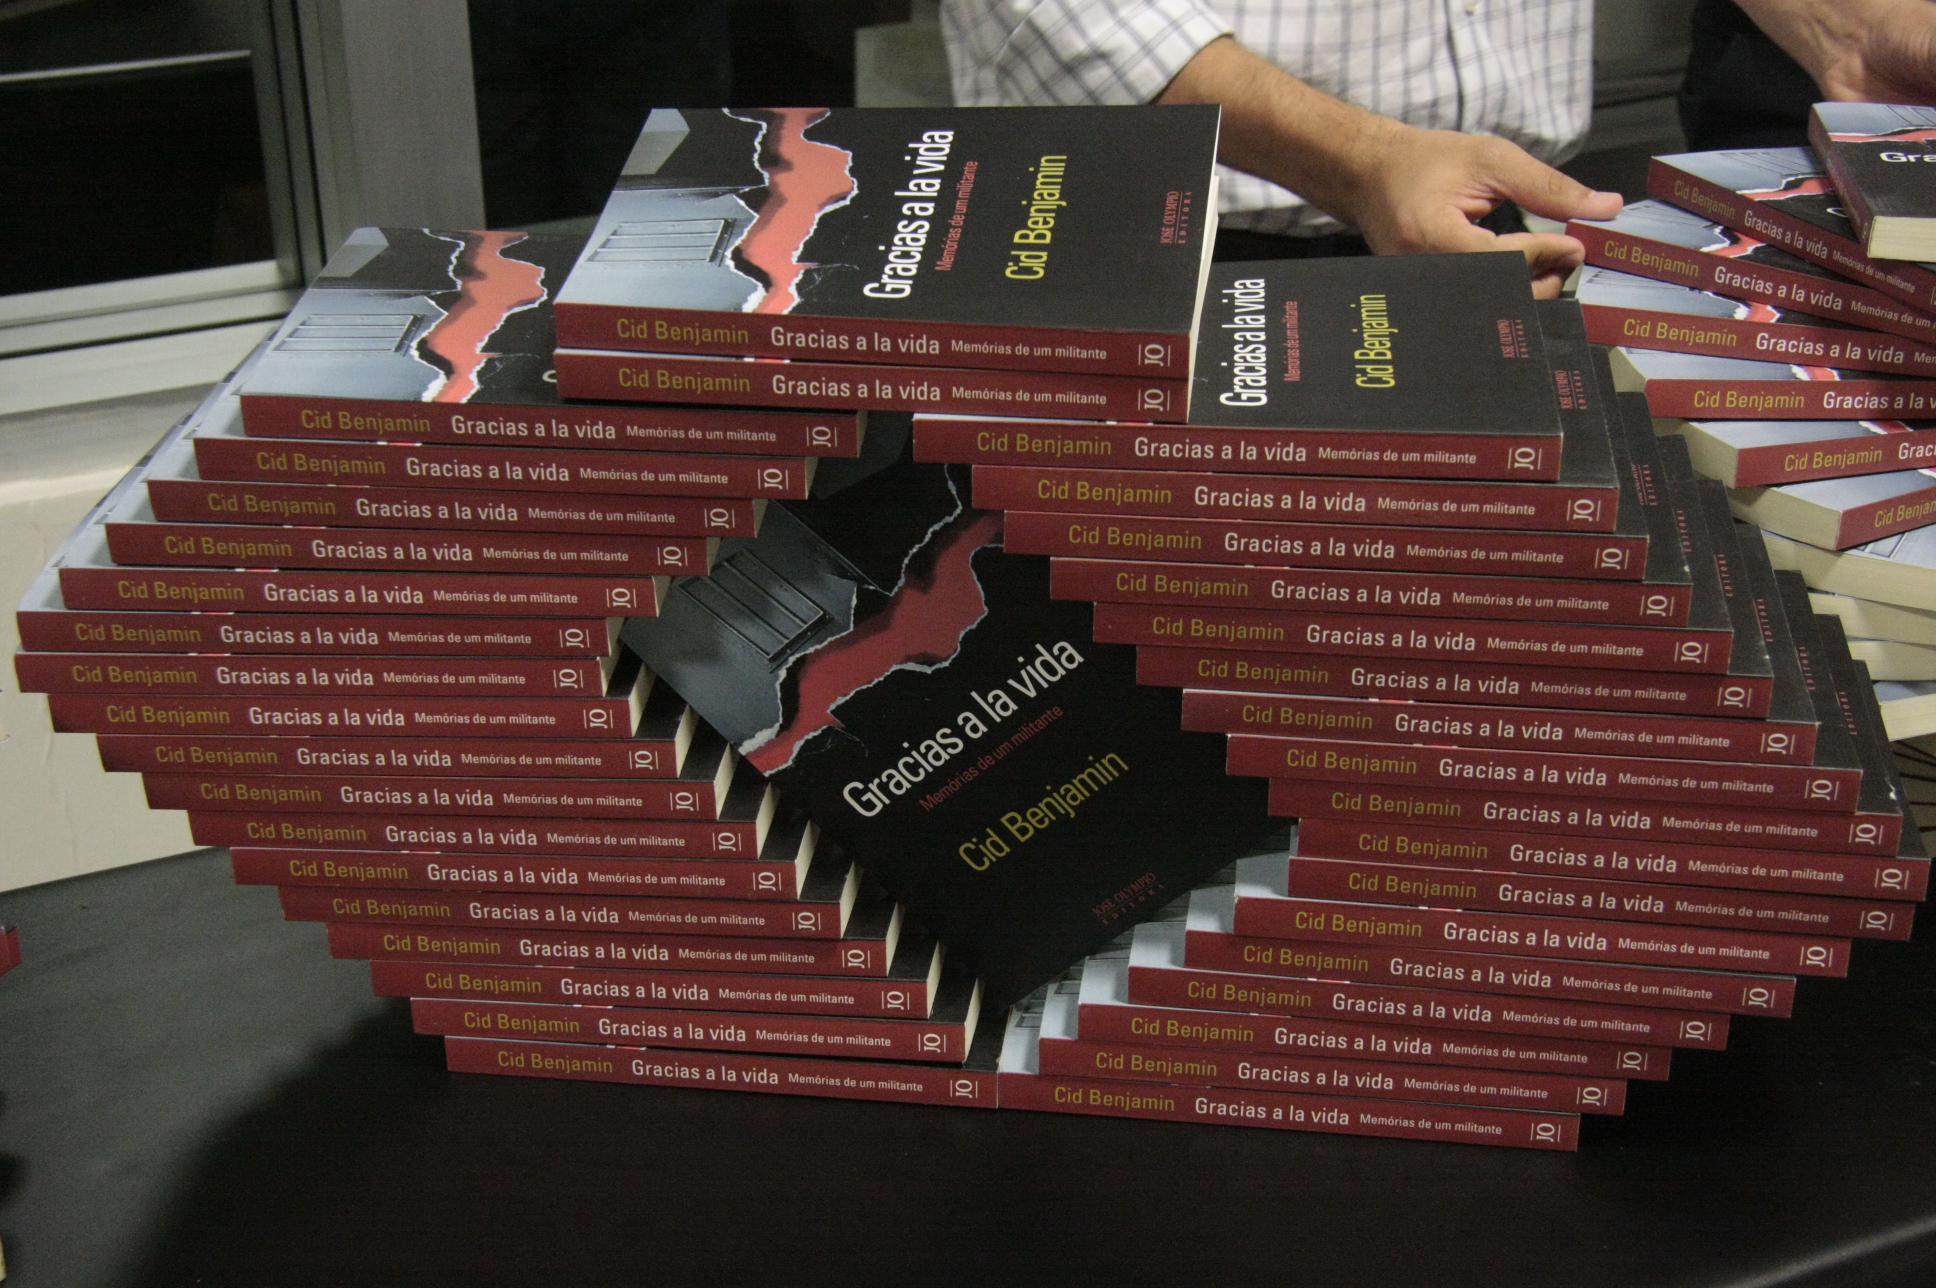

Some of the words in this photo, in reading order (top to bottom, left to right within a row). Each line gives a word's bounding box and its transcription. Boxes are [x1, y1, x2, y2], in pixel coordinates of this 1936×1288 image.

[904, 130, 954, 175] vida
[894, 178, 942, 196] la
[956, 160, 979, 198] militante
[902, 202, 936, 216] a
[954, 199, 968, 214] um
[1013, 155, 1068, 244] Benjamin
[1163, 190, 1179, 224] OLYMPIO
[948, 214, 965, 226] de
[1178, 191, 1192, 244] EDITORA
[1674, 179, 1690, 200] Cid
[1690, 186, 1736, 219] Benjamin
[1744, 209, 1783, 240] Gracias
[1784, 231, 1792, 244] a
[1793, 230, 1804, 249] la
[1806, 239, 1828, 259] vida
[1865, 264, 1874, 276] de
[1874, 270, 1886, 280] um
[862, 220, 931, 299] Gracias
[934, 227, 962, 272] Memórias
[1005, 250, 1048, 280] Cid
[1222, 278, 1266, 313] vida
[1604, 240, 1628, 260] Cid
[1630, 246, 1699, 277] Benjamin
[1714, 265, 1773, 295] Gracias
[1777, 284, 1787, 298] a
[1790, 283, 1805, 302] la
[1810, 289, 1842, 311] vida
[1850, 300, 1899, 321] Memórias
[1900, 312, 1914, 324] de
[1915, 317, 1931, 328] um
[1221, 314, 1266, 328] la
[1282, 300, 1299, 329] militante
[1350, 294, 1399, 360] Benjamin
[616, 317, 648, 339] Cid
[654, 320, 749, 346] Benjamin
[770, 325, 849, 350] Gracias
[855, 335, 867, 351] a
[874, 331, 891, 352] la
[897, 333, 940, 354] vida
[951, 339, 1012, 355] Memórias
[1014, 343, 1030, 356] de
[1033, 347, 1052, 356] um
[1054, 345, 1107, 360] militante
[1233, 331, 1266, 342] a
[1283, 339, 1300, 348] de
[1286, 329, 1299, 339] um
[1623, 318, 1651, 337] Cid
[1655, 321, 1737, 346] Benjamin
[1755, 332, 1824, 356] Gracias
[1829, 344, 1840, 357] a
[1845, 341, 1861, 360] la
[1867, 344, 1904, 364] vida
[1219, 343, 1268, 407] Gracias
[1284, 348, 1300, 382] Memórias
[1355, 364, 1396, 388] Cid
[1693, 390, 1720, 408] Cid
[1725, 390, 1805, 412] Benjamin
[1823, 391, 1889, 409] Gracias
[1893, 396, 1903, 409] a
[1908, 392, 1924, 409] la
[301, 409, 332, 429] Cid
[337, 410, 431, 435] Benjamin
[451, 414, 528, 436] Gracias
[534, 422, 546, 437] a
[551, 418, 569, 438] la
[574, 419, 616, 439] vida
[626, 425, 685, 439] Memórias
[687, 427, 702, 439] de
[705, 430, 723, 439] um
[726, 429, 776, 442] militante
[1784, 453, 1808, 472] Cid
[1812, 446, 1883, 469] Benjamin
[1874, 507, 1894, 528] Cid
[71, 664, 102, 683] Cid
[107, 665, 197, 687] Benjamin
[216, 666, 291, 685] Gracias
[295, 671, 307, 685] a
[311, 667, 329, 685] la
[334, 668, 374, 686] vida
[383, 671, 439, 684] Memórias
[441, 672, 456, 684] de
[458, 675, 476, 684] um
[478, 673, 526, 685] militante
[1007, 640, 1085, 699] vida
[970, 690, 1019, 722] la
[956, 710, 988, 740] a
[1242, 704, 1273, 723] Cid
[1280, 706, 1373, 730] Benjamin
[1395, 713, 1473, 735] Gracias
[1479, 722, 1490, 736] a
[1497, 719, 1515, 738] la
[1521, 721, 1563, 741] vida
[1574, 727, 1635, 742] Memórias
[1637, 731, 1653, 743] de
[1656, 735, 1675, 744] um
[1677, 734, 1730, 747] militante
[842, 724, 965, 818] Gracias
[918, 764, 979, 812] Memórias
[976, 750, 996, 771] de
[993, 740, 1014, 760] um
[1010, 704, 1064, 748] militante
[958, 827, 1011, 872] Cid
[1000, 752, 1129, 843] Benjamin
[497, 1050, 525, 1068] Cid
[530, 1052, 613, 1074] Benjamin
[631, 1059, 700, 1079] Gracias
[705, 1068, 715, 1080] a
[721, 1065, 736, 1082] la
[741, 1067, 778, 1084] vida
[788, 1072, 841, 1086] Memórias
[843, 1076, 857, 1087] de
[859, 1080, 876, 1088] um
[877, 1080, 923, 1092] militante
[1054, 1086, 1082, 1104] Cid
[1089, 1088, 1175, 1111] Benjamin
[1195, 1097, 1266, 1119] Gracias
[1272, 1107, 1283, 1120] a
[1289, 1104, 1305, 1122] la
[1310, 1107, 1349, 1125] vida
[1359, 1113, 1415, 1128] Memórias
[1417, 1118, 1432, 1129] de
[1434, 1122, 1452, 1130] um
[1454, 1121, 1502, 1135] militante
